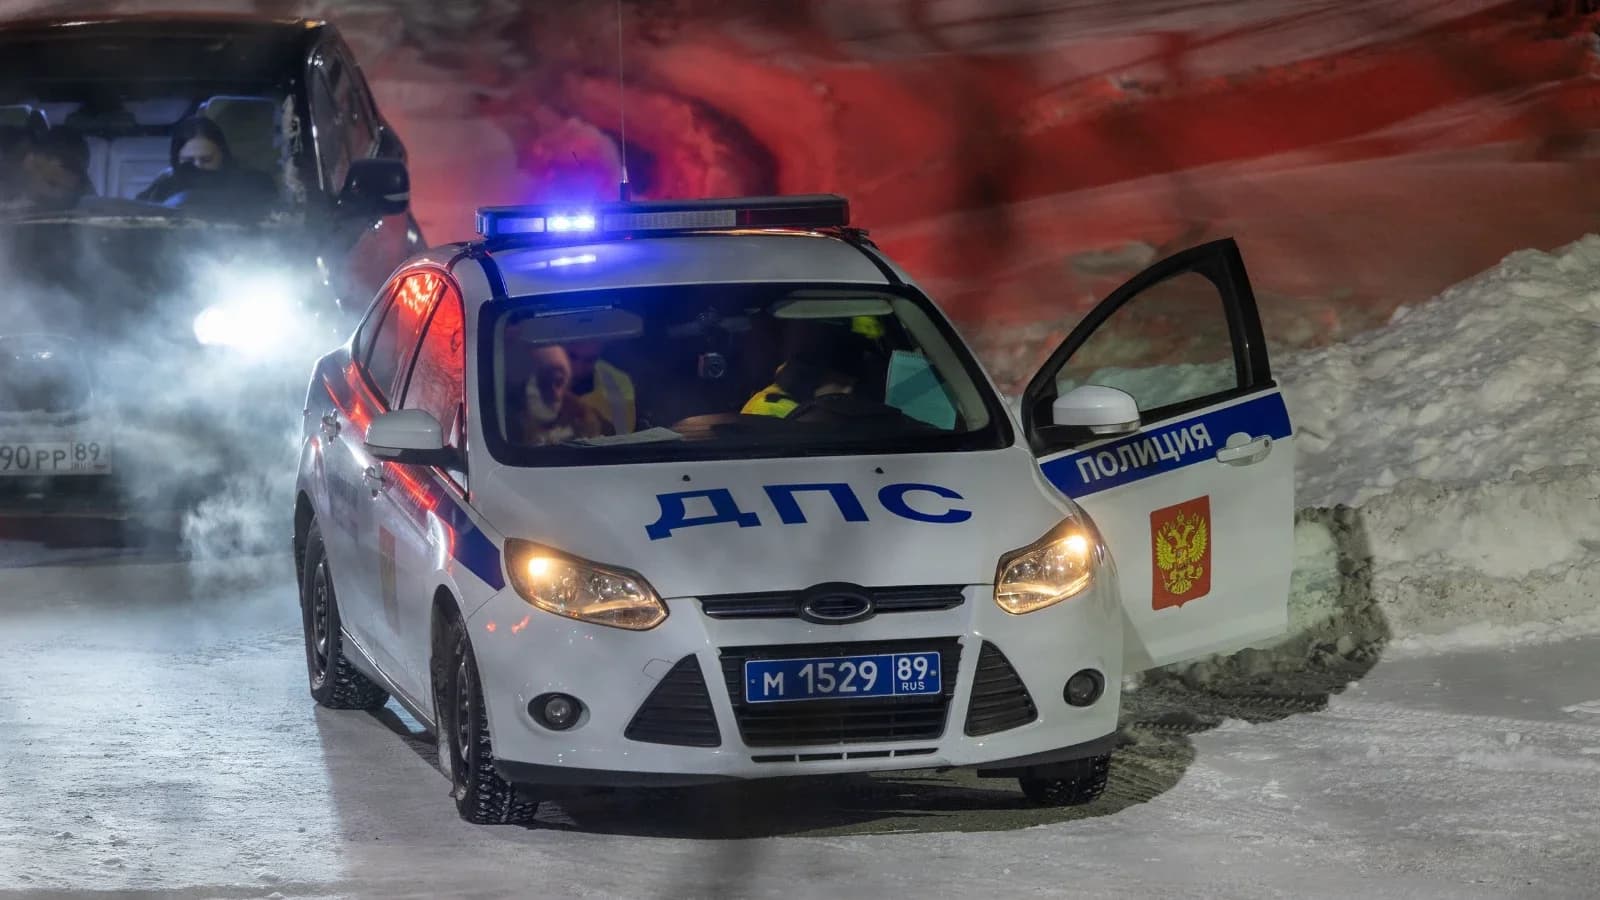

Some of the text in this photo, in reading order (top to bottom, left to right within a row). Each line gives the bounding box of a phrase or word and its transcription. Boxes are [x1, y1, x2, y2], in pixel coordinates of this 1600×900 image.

[75, 442, 100, 461] 89
[1075, 422, 1214, 484] ПОЛИЦИЯ
[644, 482, 973, 541] ДПС
[798, 660, 878, 694] 1529
[897, 656, 928, 681] 89
[902, 681, 925, 691] RUS
